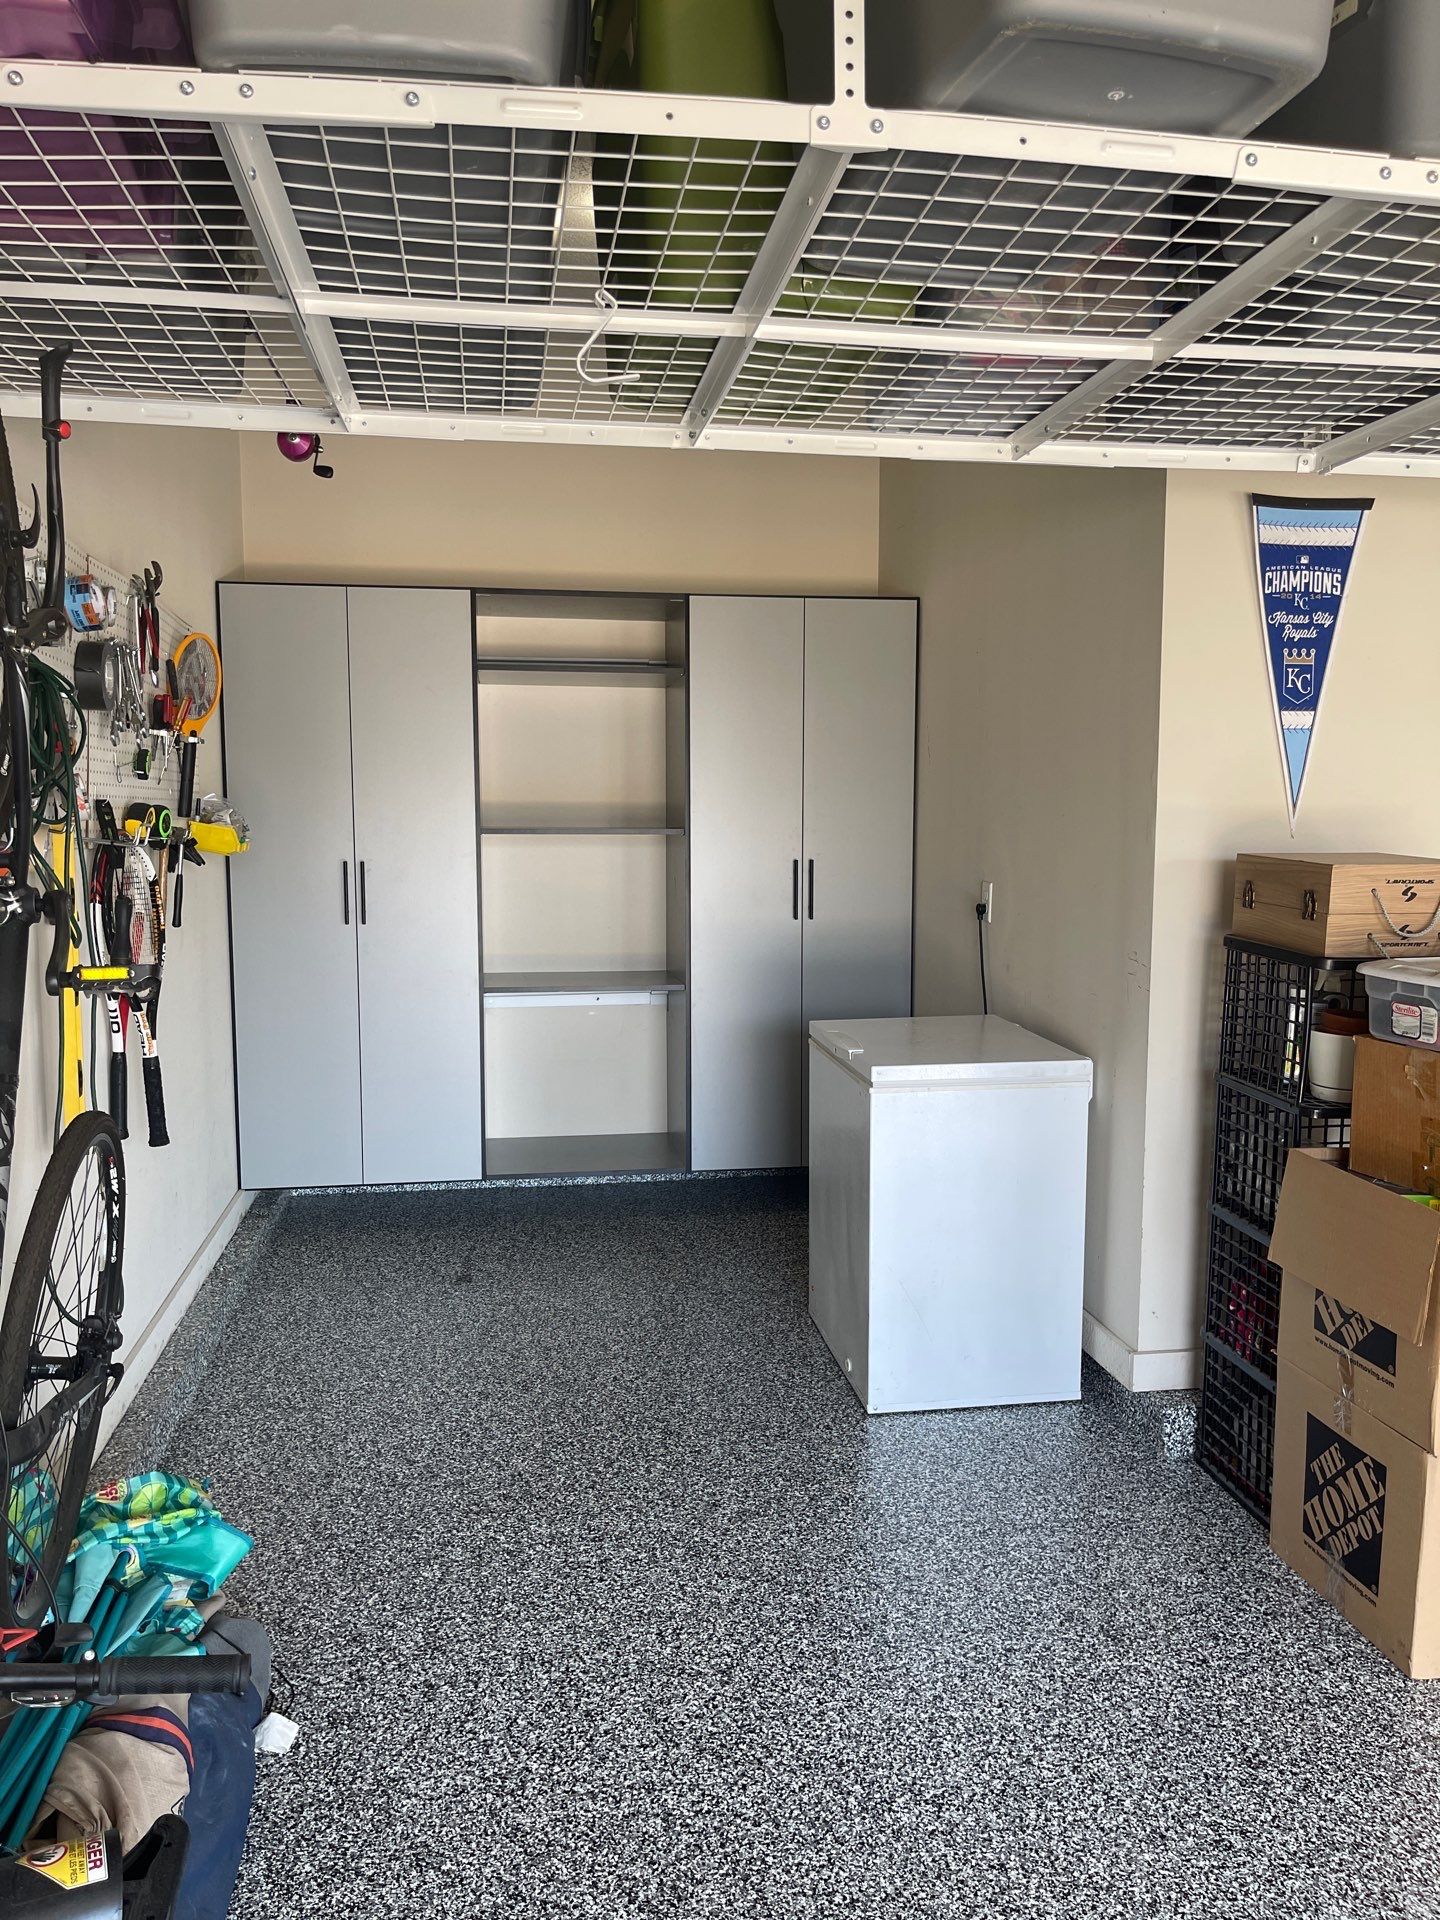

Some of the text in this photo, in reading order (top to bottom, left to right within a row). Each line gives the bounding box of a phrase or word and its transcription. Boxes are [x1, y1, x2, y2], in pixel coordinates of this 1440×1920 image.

[1309, 565, 1342, 573] LEAGUE
[1264, 570, 1342, 595] CHAMPIONS
[1268, 611, 1334, 628] Kansas City
[1282, 624, 1318, 642] Royals
[1286, 668, 1311, 694] KC
[1395, 1004, 1419, 1016] Sterilite
[1310, 1442, 1346, 1486] THE
[1303, 1455, 1386, 1543] HOME
[1327, 1505, 1383, 1561] DEPOT
[86, 1834, 104, 1872] NGER
